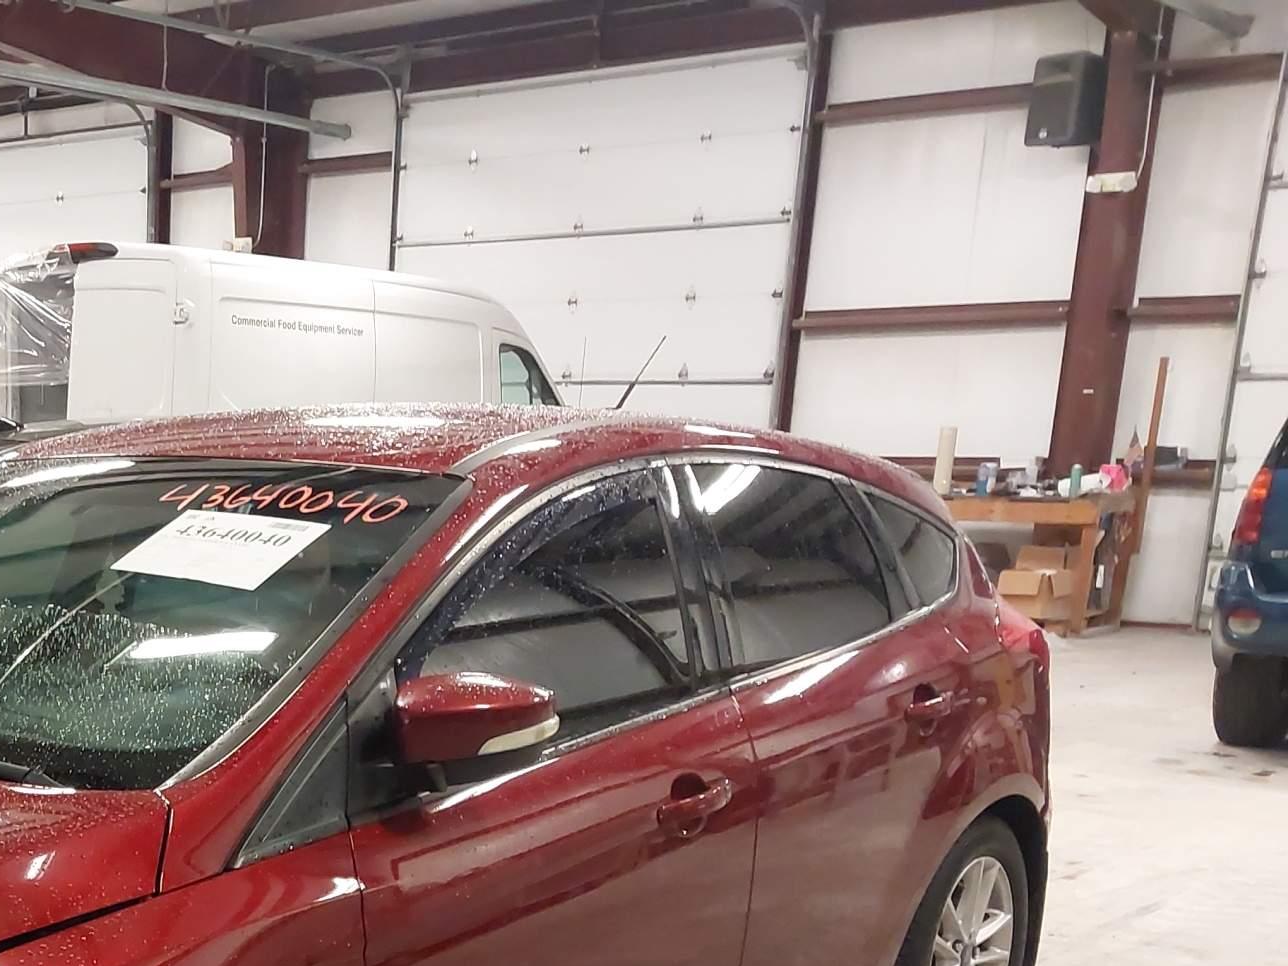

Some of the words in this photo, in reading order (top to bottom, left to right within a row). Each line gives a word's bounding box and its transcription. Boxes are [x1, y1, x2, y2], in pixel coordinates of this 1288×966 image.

[231, 314, 275, 329] Commercial
[278, 319, 296, 330] Food
[298, 321, 335, 335] Equipment
[160, 484, 409, 524] 43640040
[176, 524, 292, 547] 43640040
